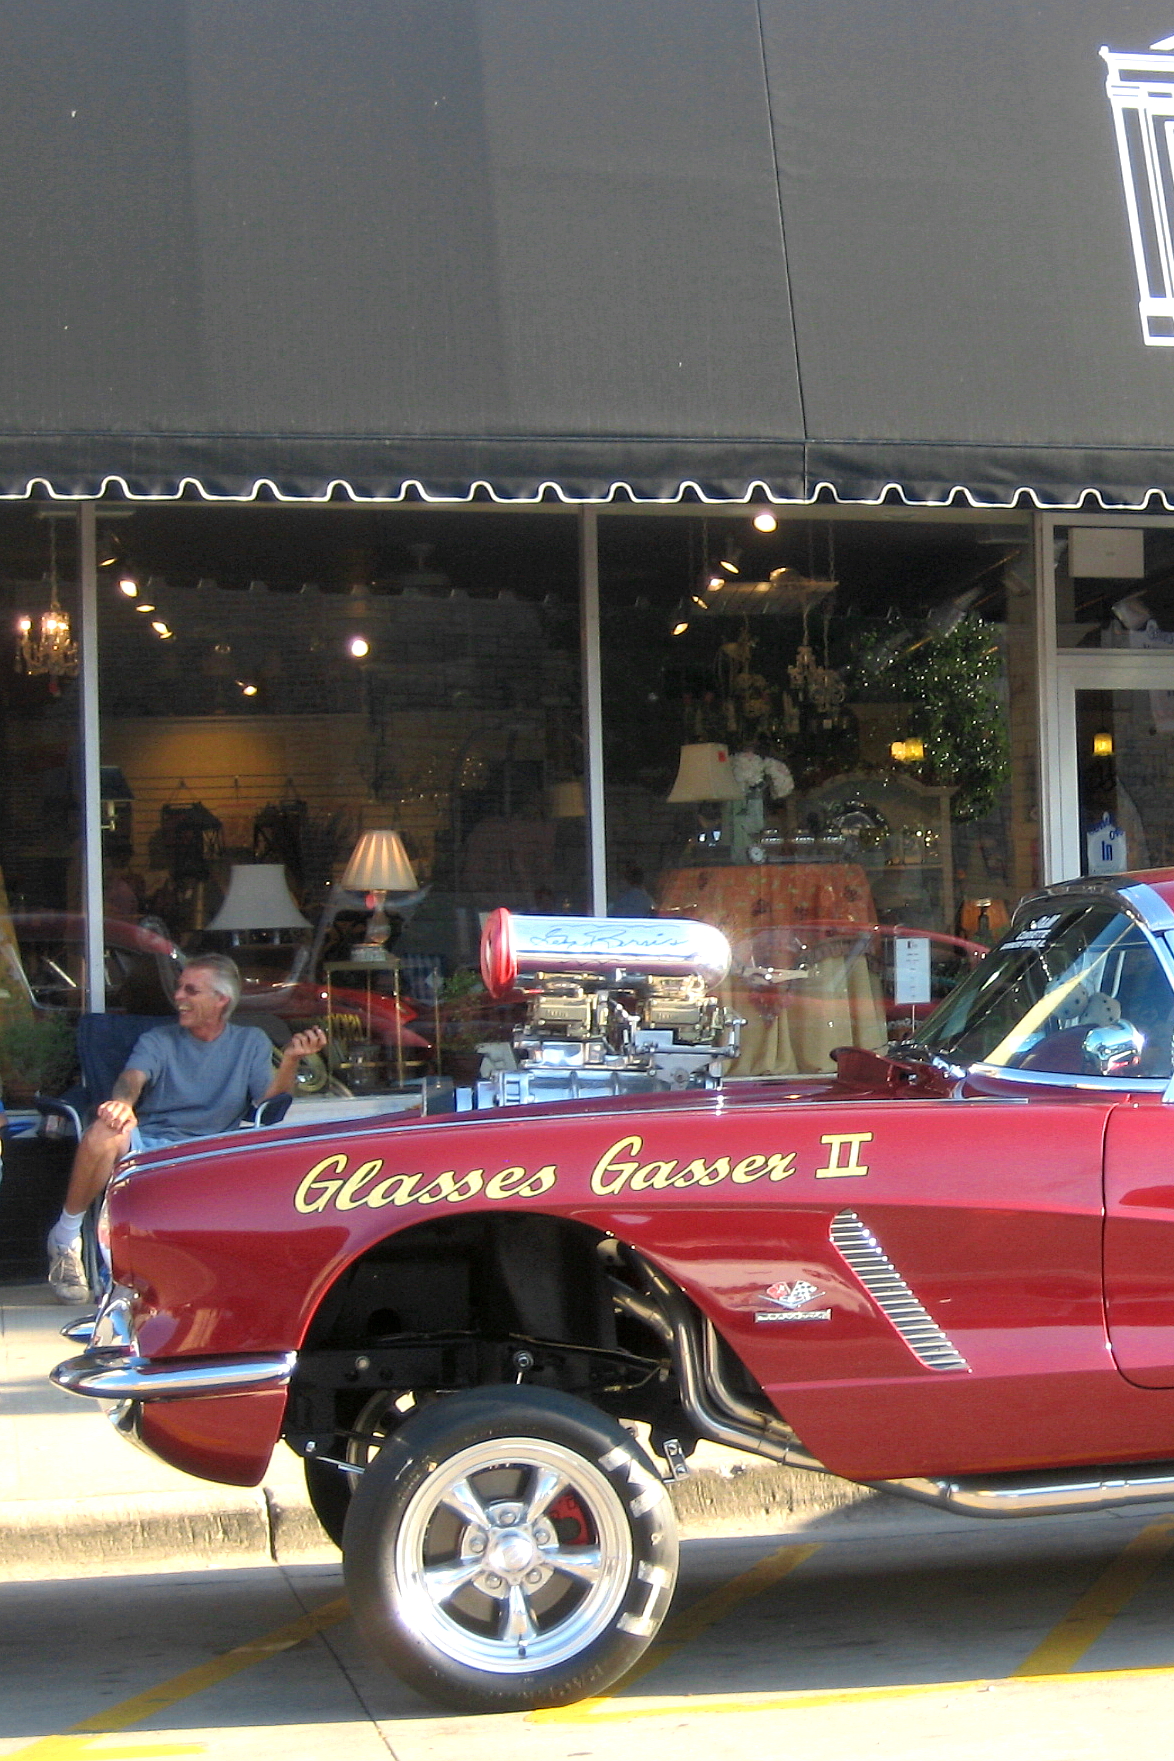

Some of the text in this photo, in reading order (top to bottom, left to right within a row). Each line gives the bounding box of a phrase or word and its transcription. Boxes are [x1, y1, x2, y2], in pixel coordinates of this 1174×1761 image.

[1102, 840, 1113, 861] In
[294, 1132, 873, 1213] Glasses Gasser II
